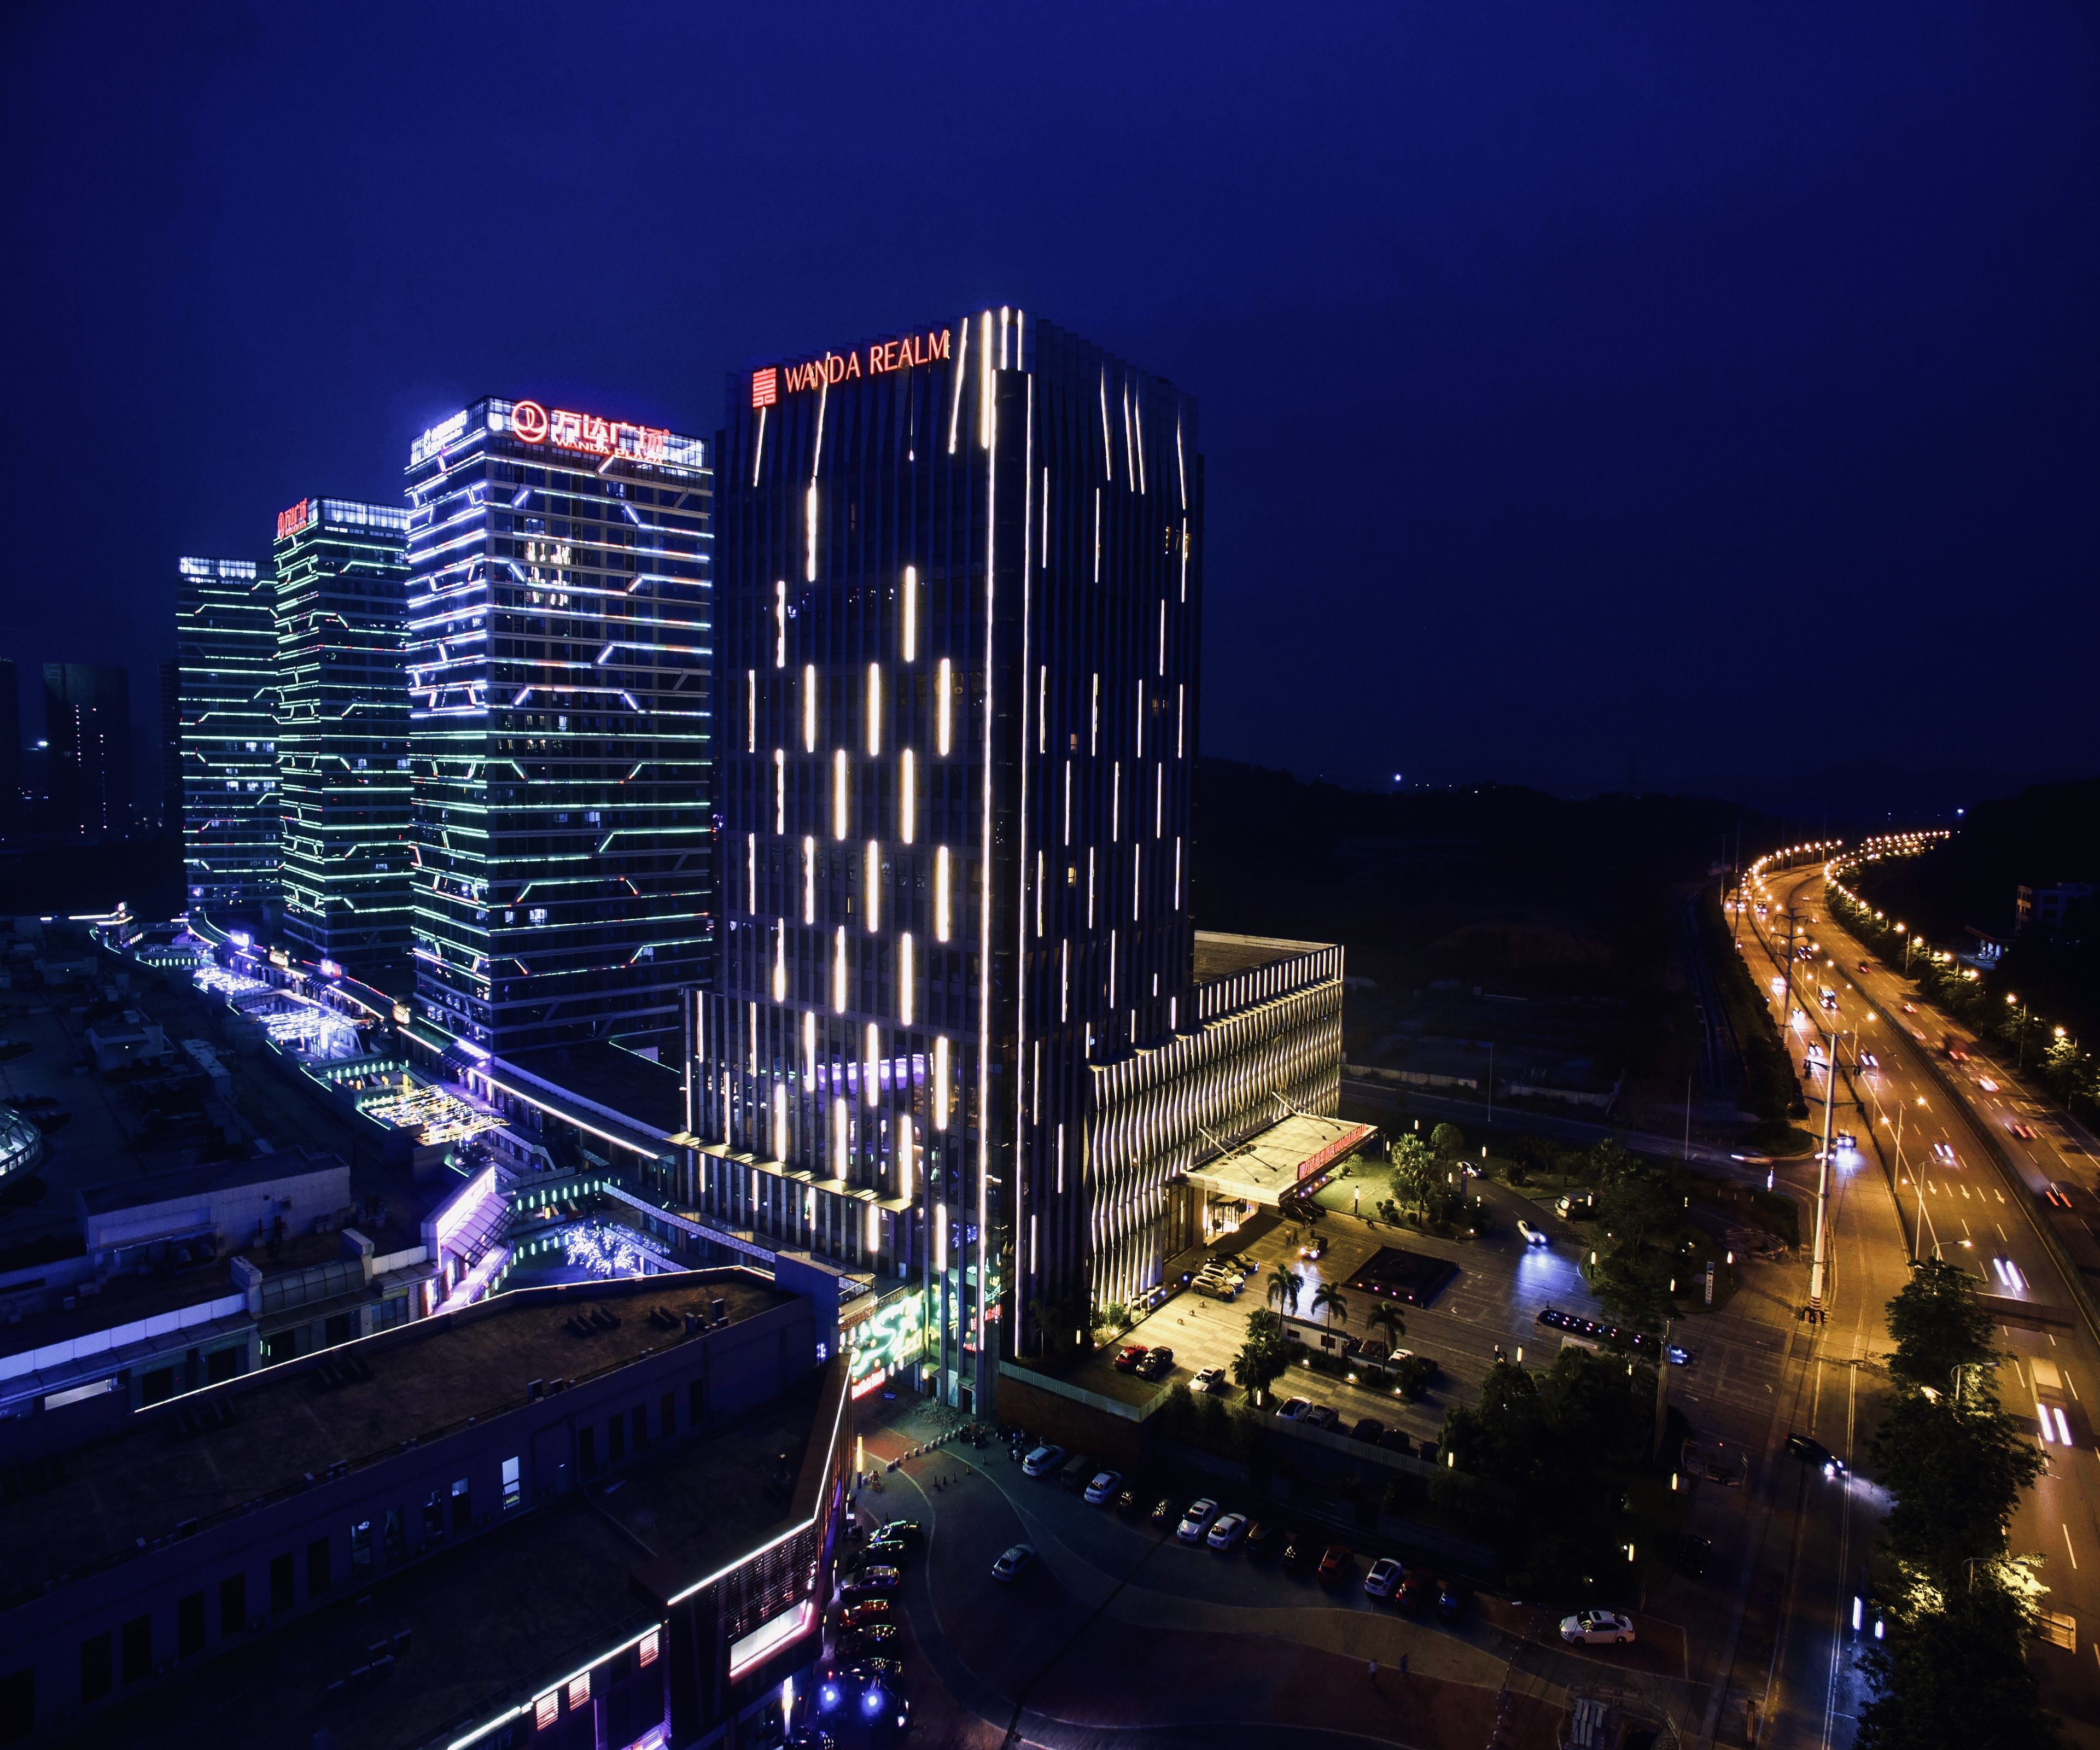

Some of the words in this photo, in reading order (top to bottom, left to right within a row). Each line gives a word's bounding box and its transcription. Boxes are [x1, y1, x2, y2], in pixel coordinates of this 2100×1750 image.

[785, 351, 861, 393] WANDA
[871, 329, 950, 374] REALM
[553, 410, 664, 453] 万达广场
[555, 438, 610, 453] WANDA
